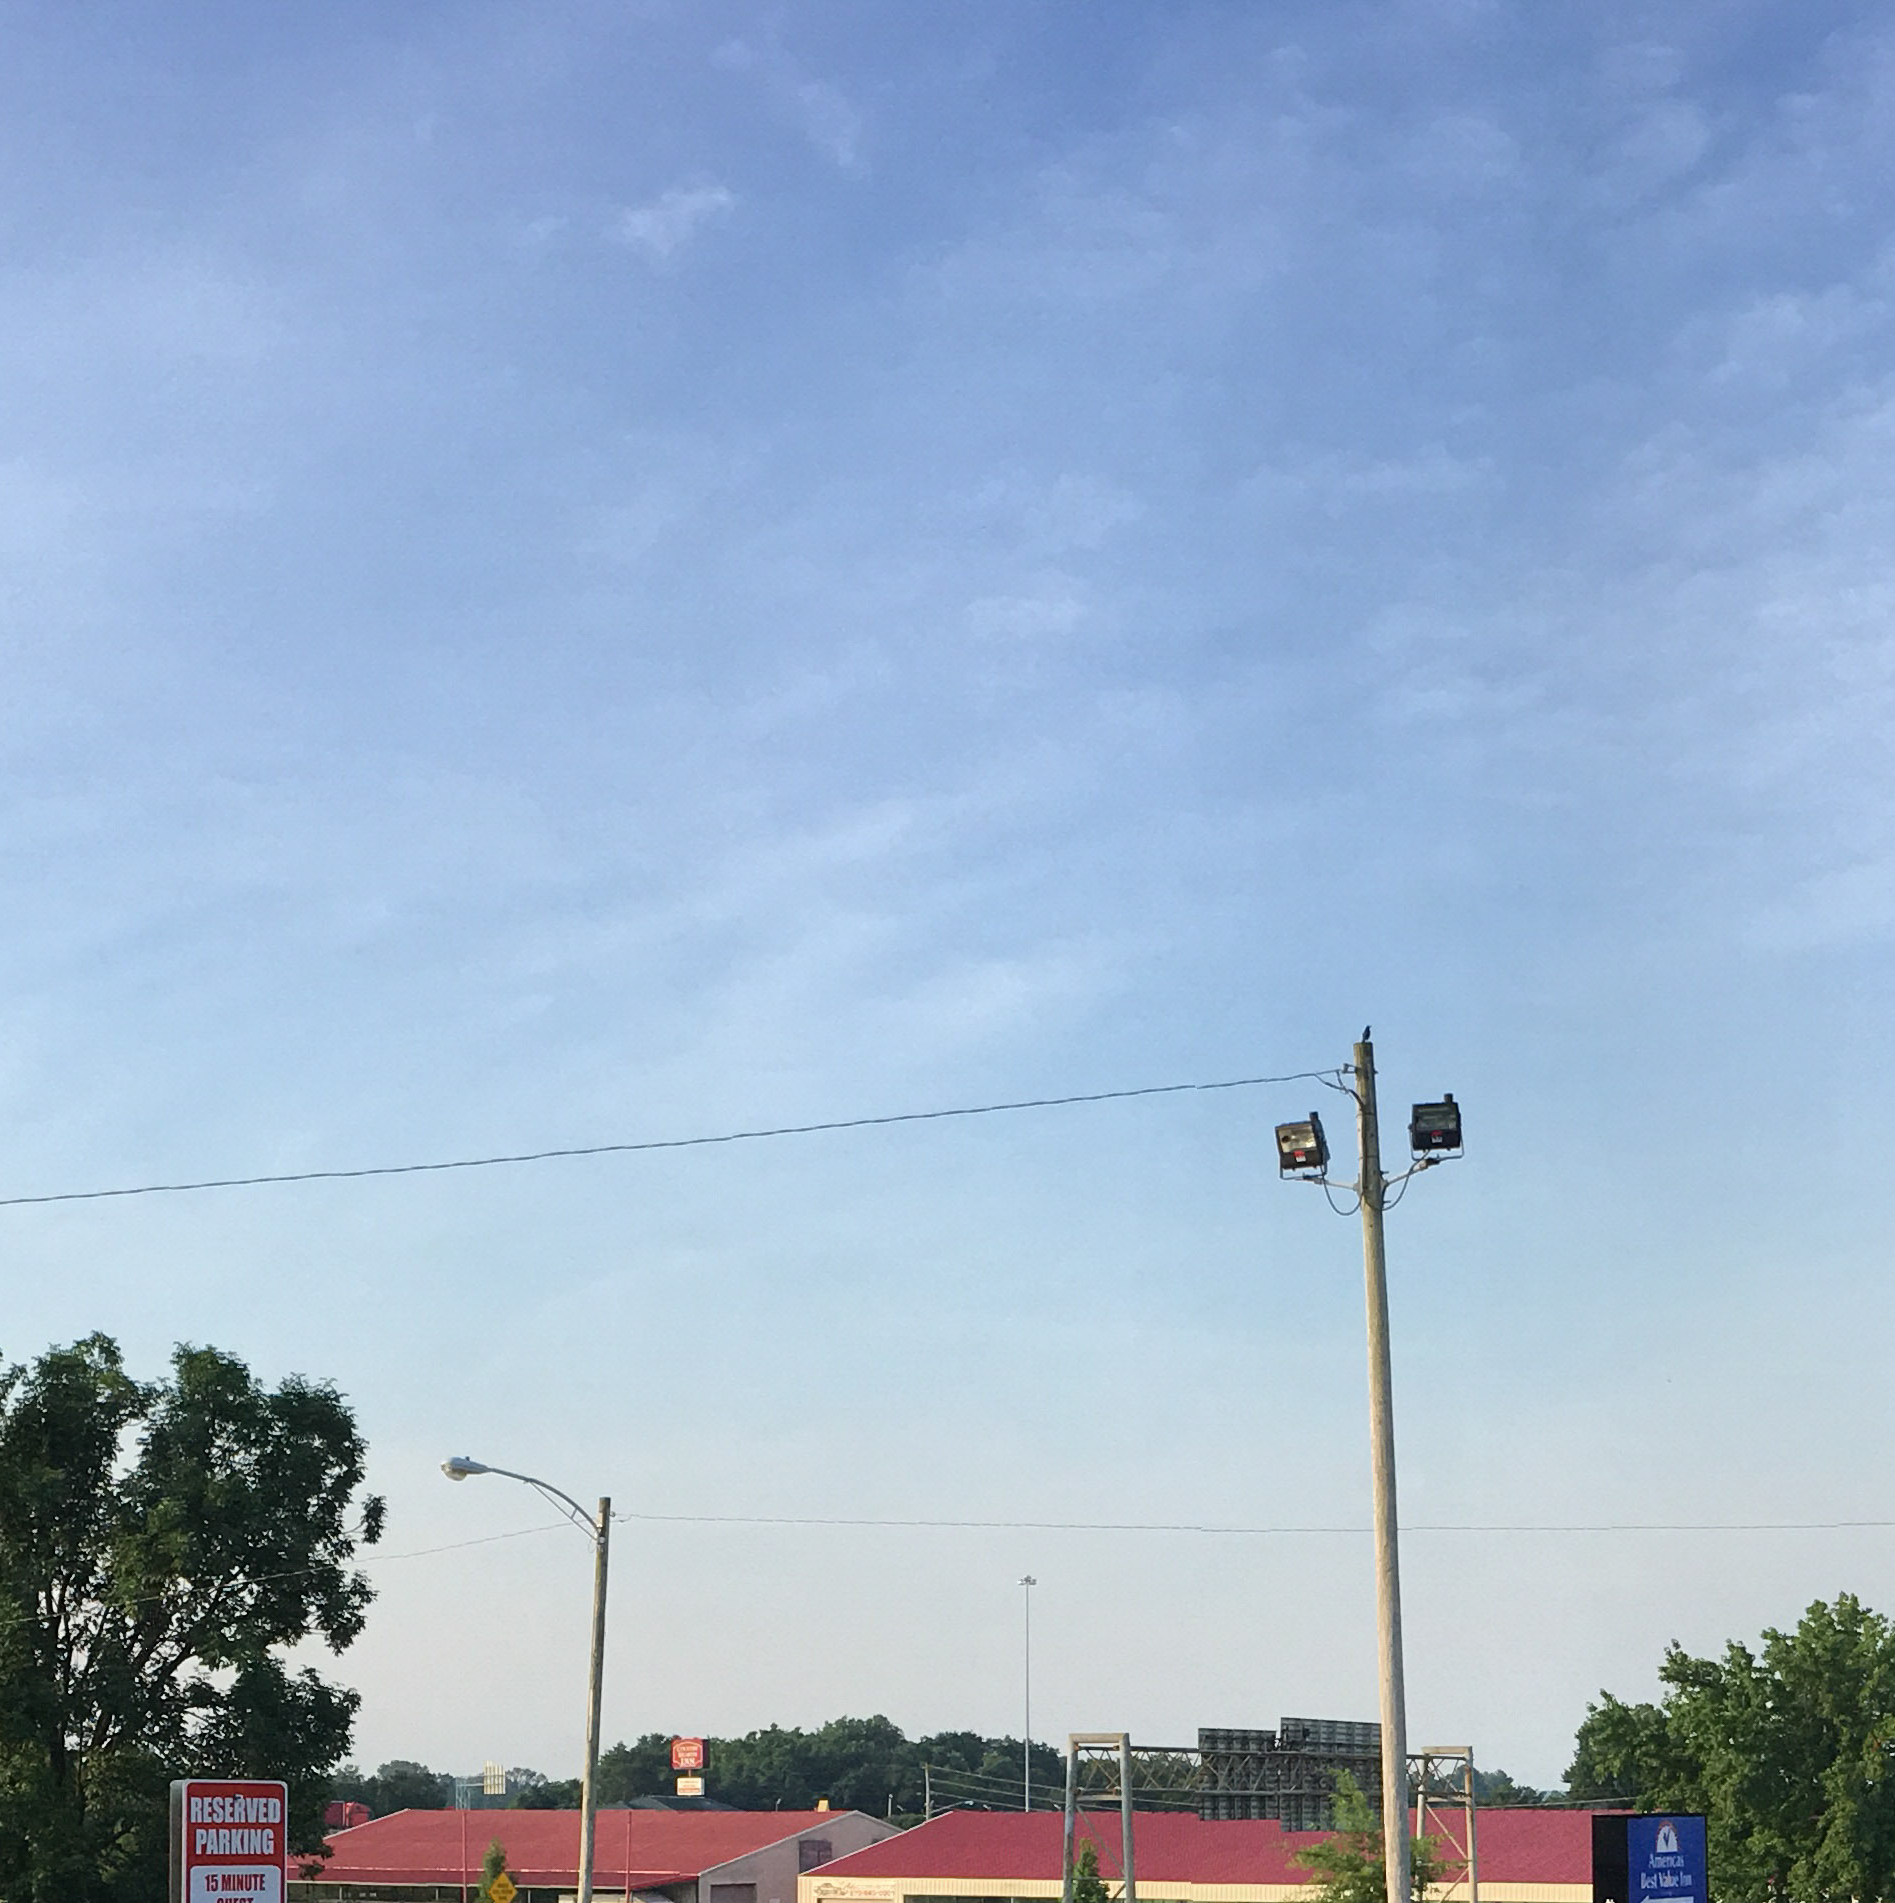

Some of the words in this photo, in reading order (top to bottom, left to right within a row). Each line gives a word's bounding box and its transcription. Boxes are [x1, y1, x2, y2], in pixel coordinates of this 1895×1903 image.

[190, 1796, 281, 1824] RESERVED
[195, 1828, 274, 1855] PARKING
[1648, 1853, 1684, 1869] Americas
[205, 1874, 218, 1892] 15
[221, 1874, 265, 1891] MINUTE
[1641, 1872, 1657, 1889] Best
[1658, 1870, 1679, 1888] Value
[1680, 1871, 1692, 1887] Inn
